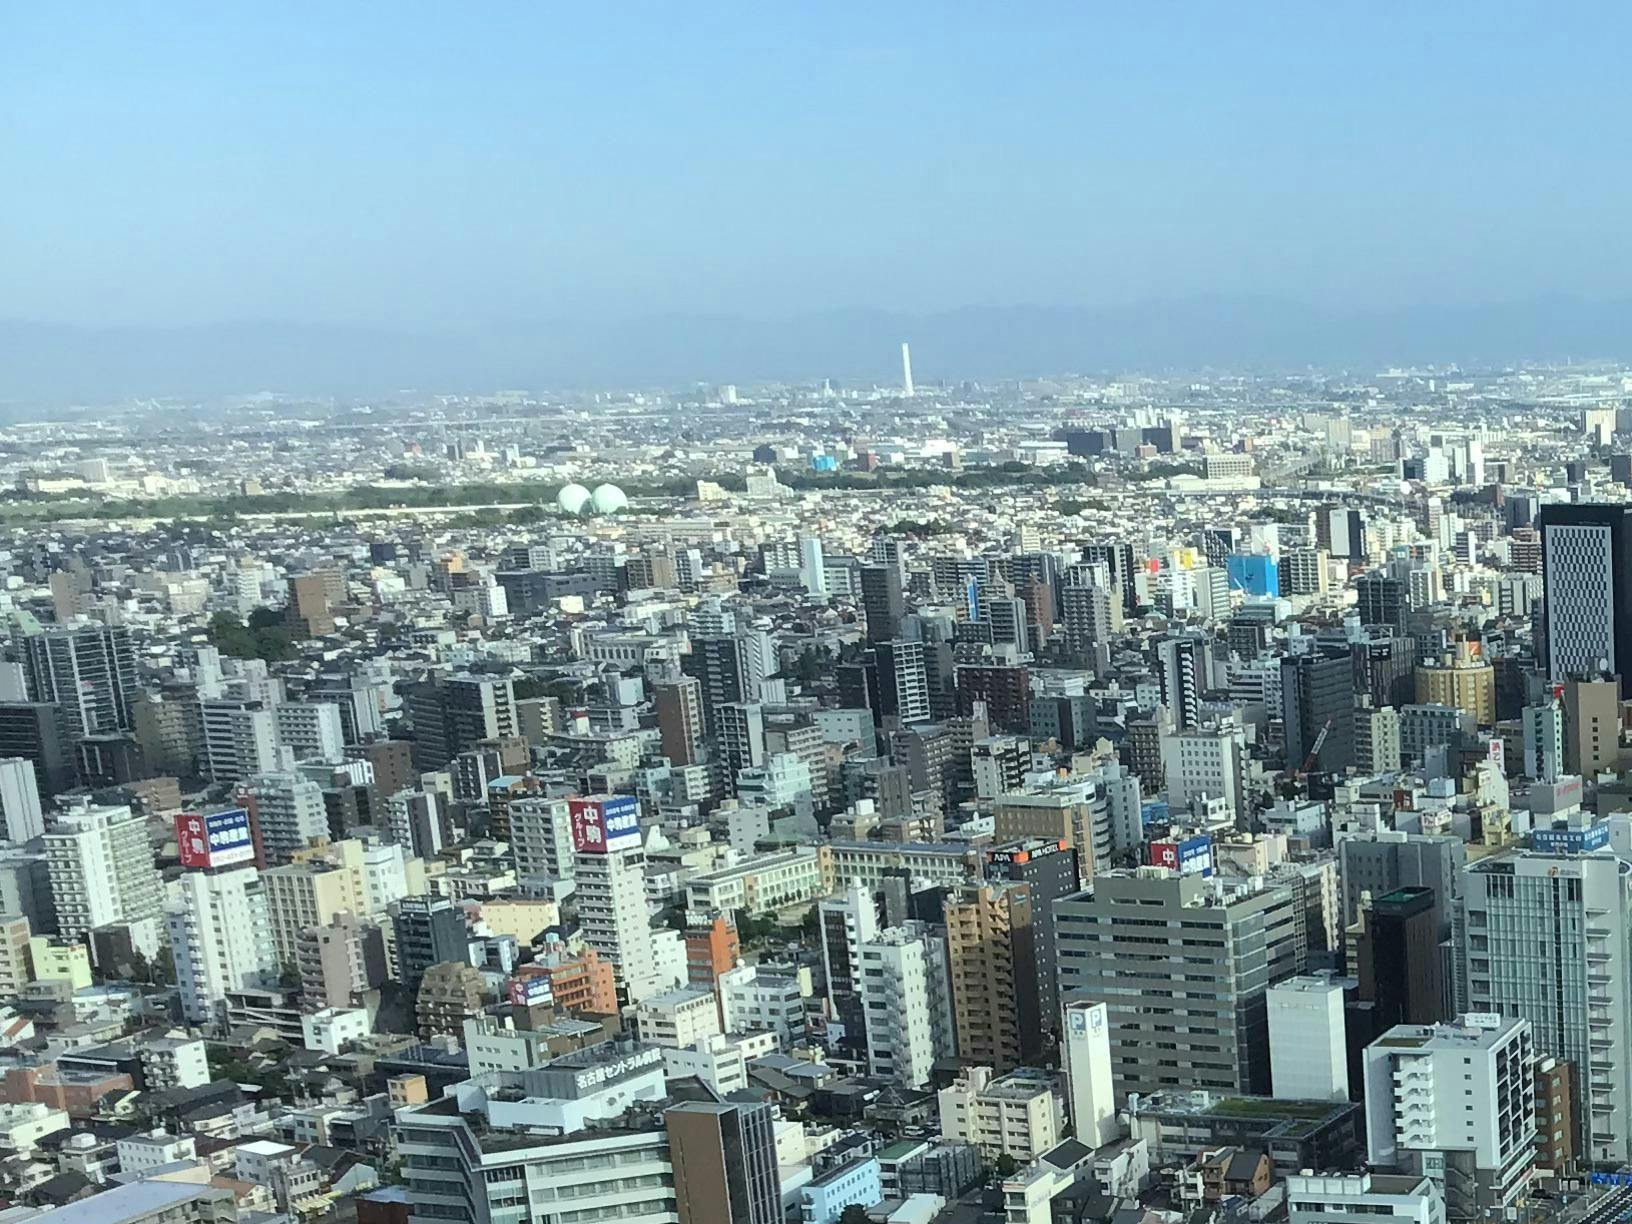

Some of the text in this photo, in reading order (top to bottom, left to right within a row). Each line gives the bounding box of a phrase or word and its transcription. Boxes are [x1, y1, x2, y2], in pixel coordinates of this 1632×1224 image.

[577, 1047, 662, 1089] 名古屋セントラル病院
